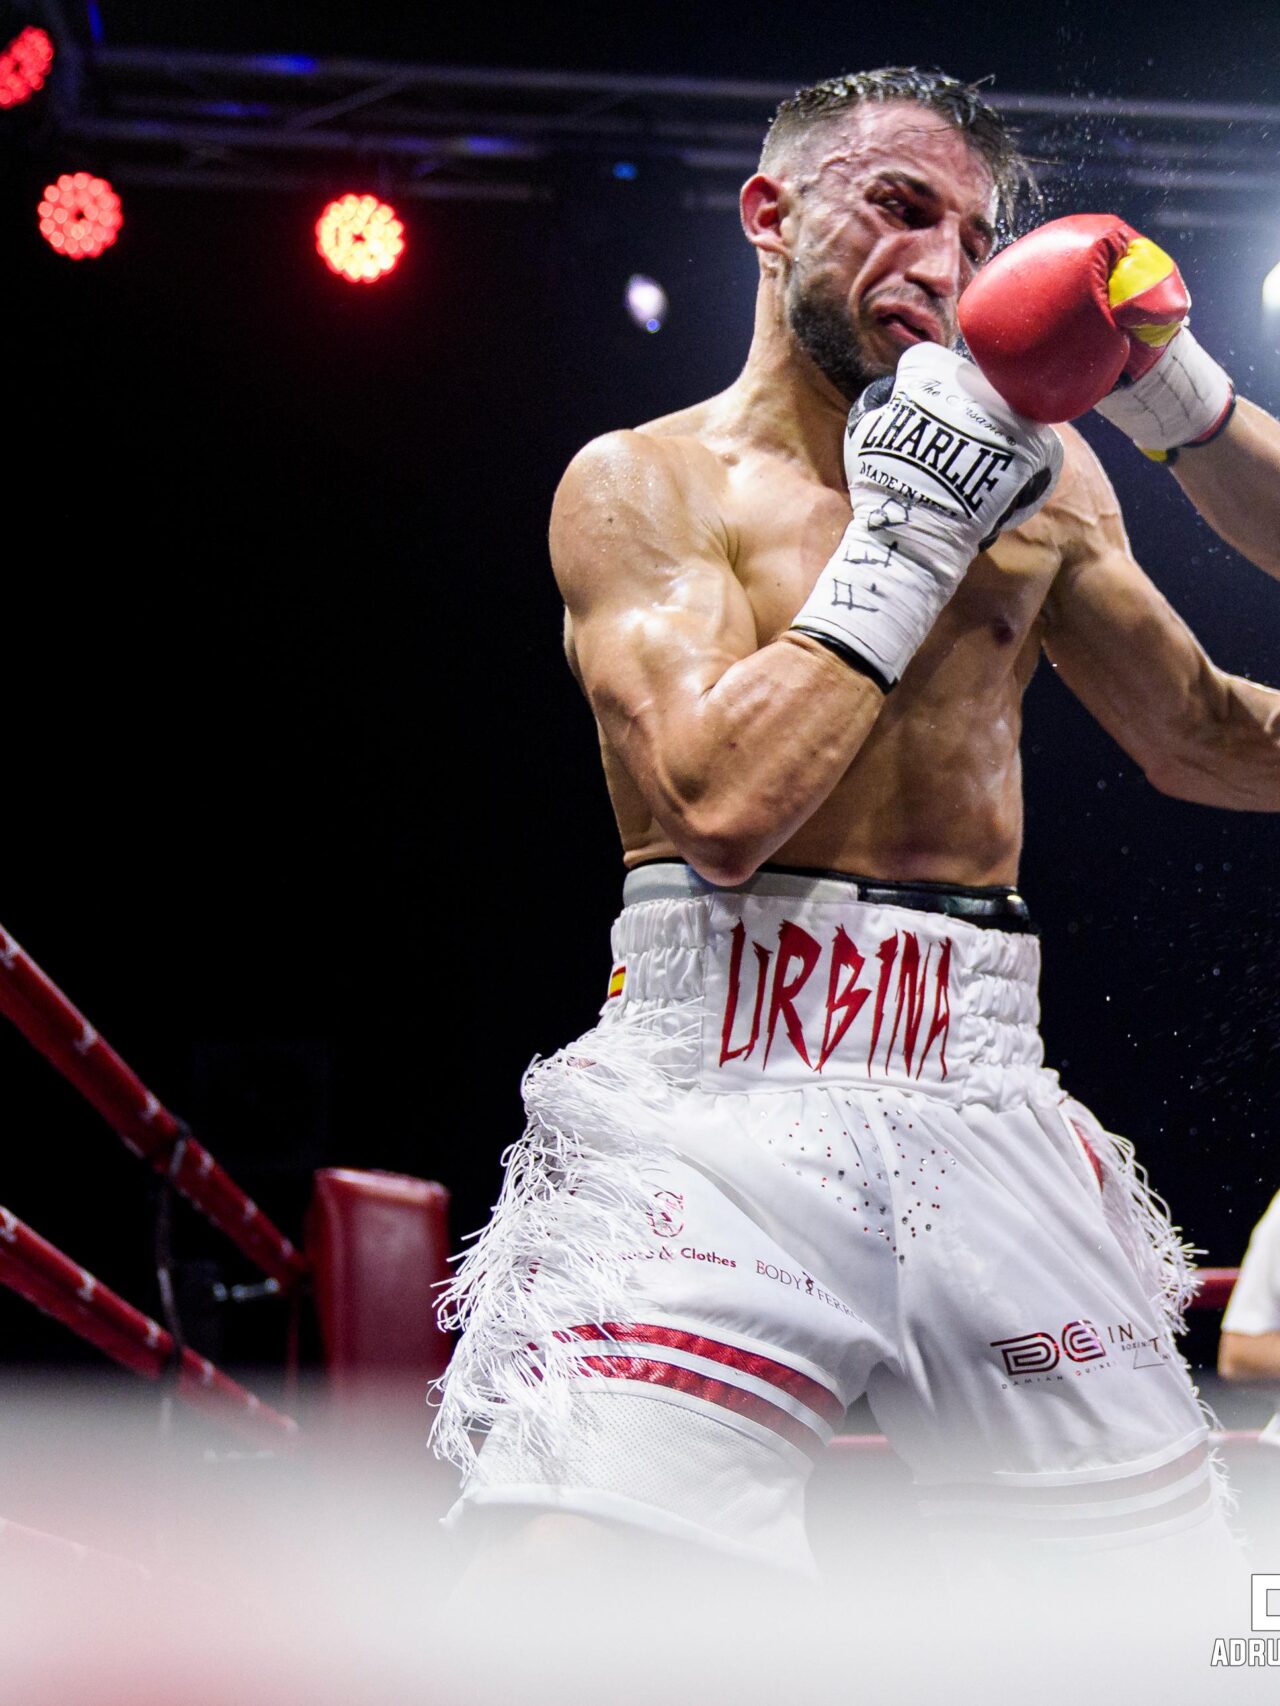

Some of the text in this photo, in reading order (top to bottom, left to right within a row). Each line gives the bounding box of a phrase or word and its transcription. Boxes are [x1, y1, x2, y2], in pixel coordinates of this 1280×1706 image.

[860, 462, 898, 490] MADE
[719, 917, 952, 1081] URBINA
[680, 1247, 737, 1269] Clothes
[756, 1260, 801, 1290] BODY
